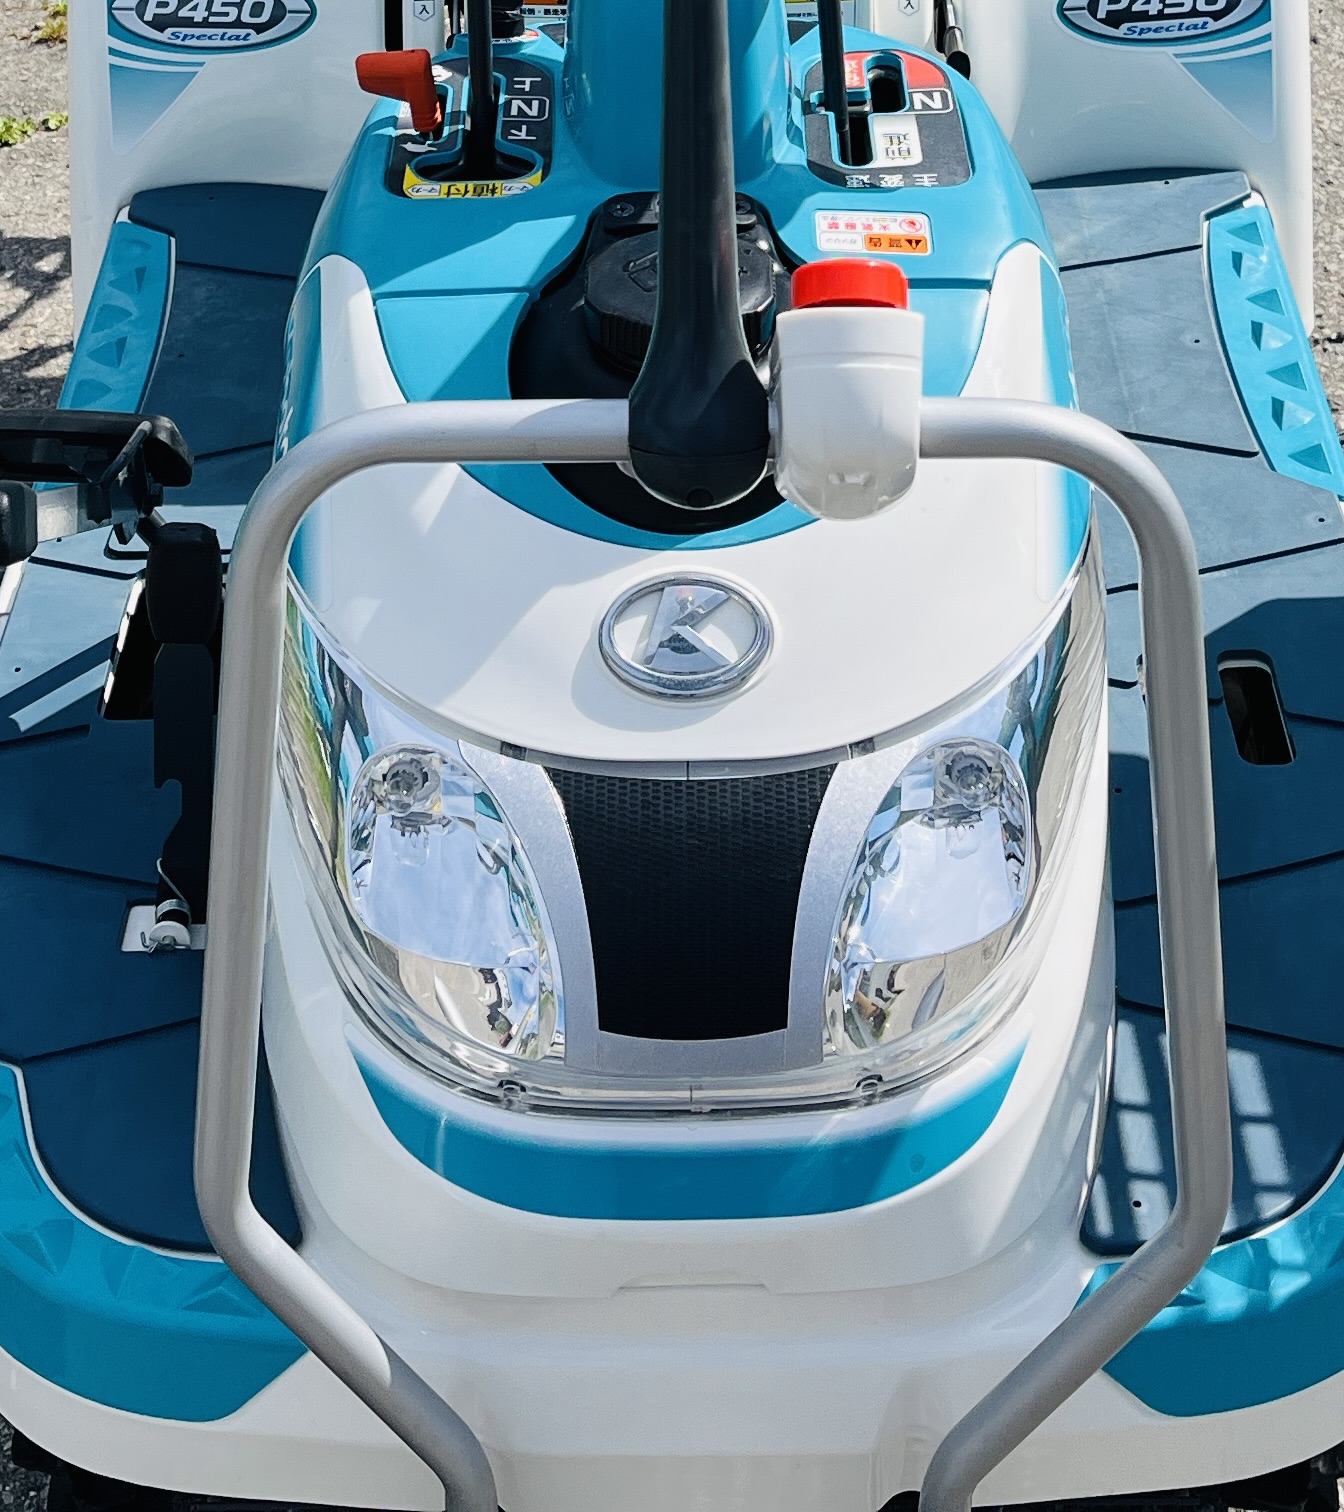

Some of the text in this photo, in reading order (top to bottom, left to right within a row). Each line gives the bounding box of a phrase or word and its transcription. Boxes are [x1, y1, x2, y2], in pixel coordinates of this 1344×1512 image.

[418, 4, 430, 16] 入
[903, 0, 915, 10] 入
[1123, 21, 1209, 36] Special
[167, 30, 252, 43] Special
[513, 77, 542, 92] 上
[510, 99, 539, 117] N
[912, 91, 943, 110] N
[507, 124, 537, 140] 下
[443, 183, 498, 198] 植付
